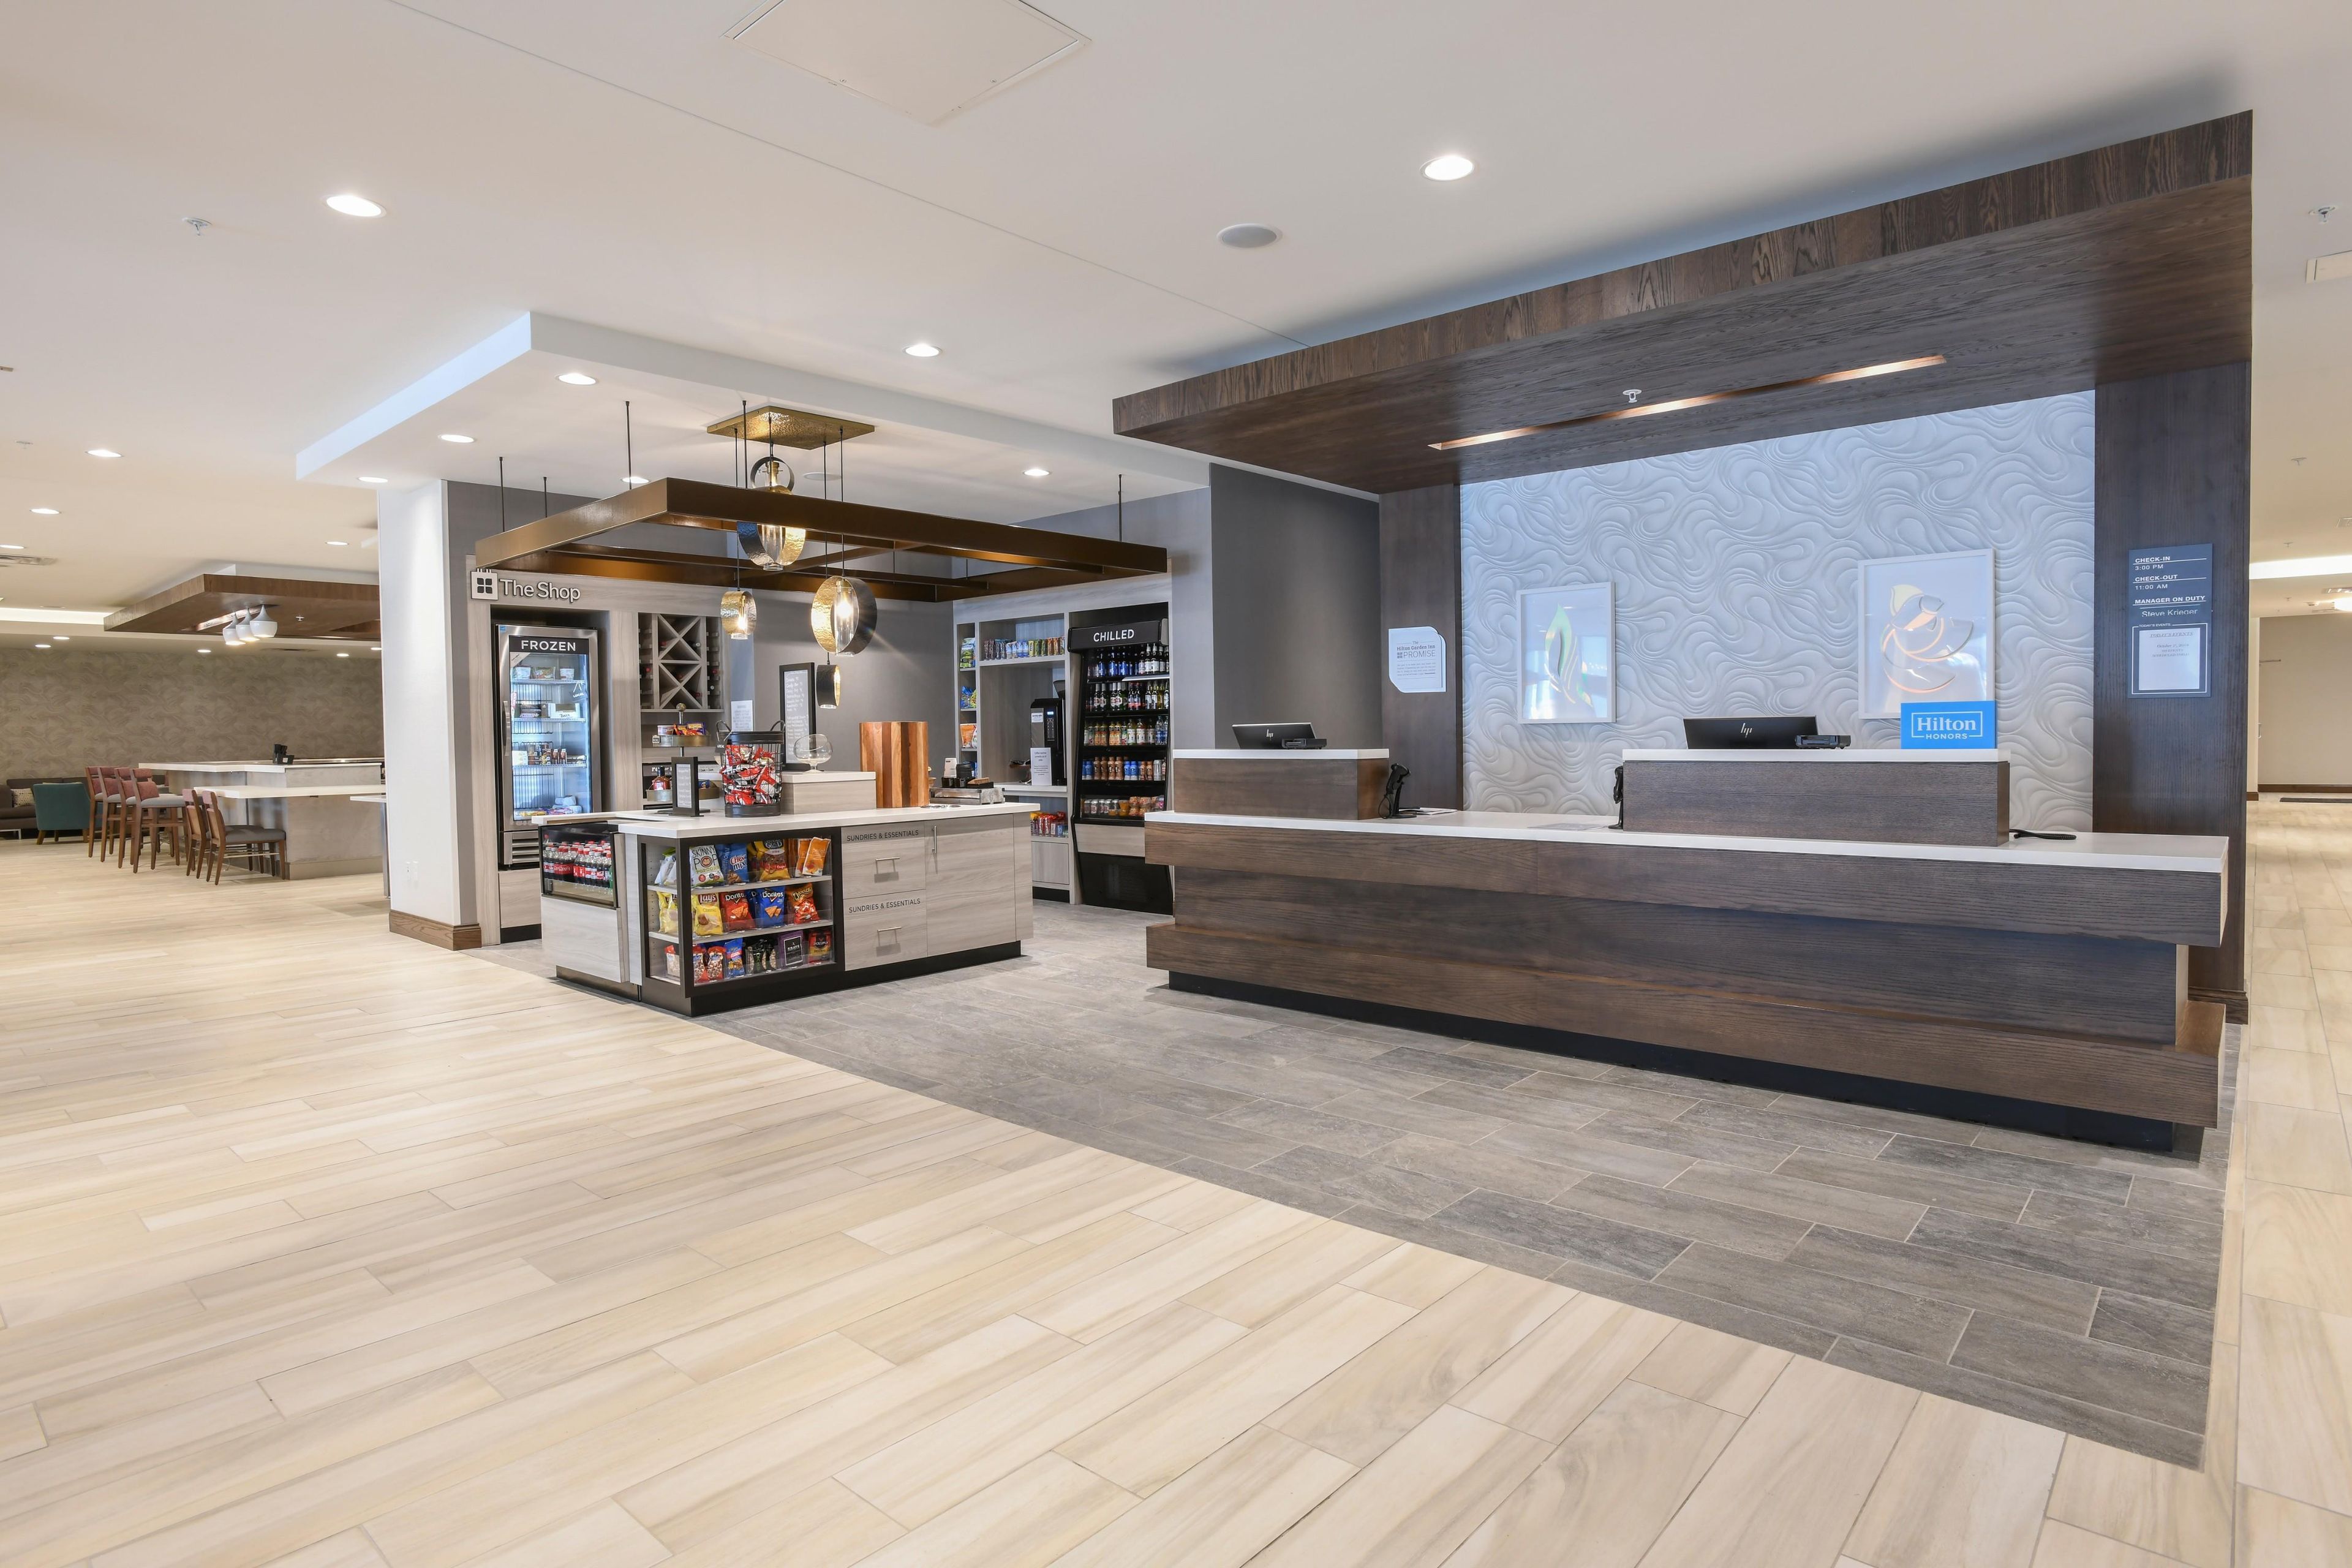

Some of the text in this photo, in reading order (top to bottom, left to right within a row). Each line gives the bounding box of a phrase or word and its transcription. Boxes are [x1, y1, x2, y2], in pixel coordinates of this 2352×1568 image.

[499, 579, 581, 603] The Shop
[1093, 629, 1134, 643] CHILLED
[521, 640, 576, 652] FROZEN
[1917, 715, 1978, 731] Hilton
[846, 831, 877, 842] SUNDRIES
[884, 829, 919, 839] ESSENTIALS
[692, 845, 716, 858] SKINNY
[693, 854, 718, 870] POP
[729, 854, 746, 865] Chex
[733, 861, 747, 872] mix
[849, 903, 880, 913] SUNDRIES
[886, 898, 921, 908] ESSENTIALS
